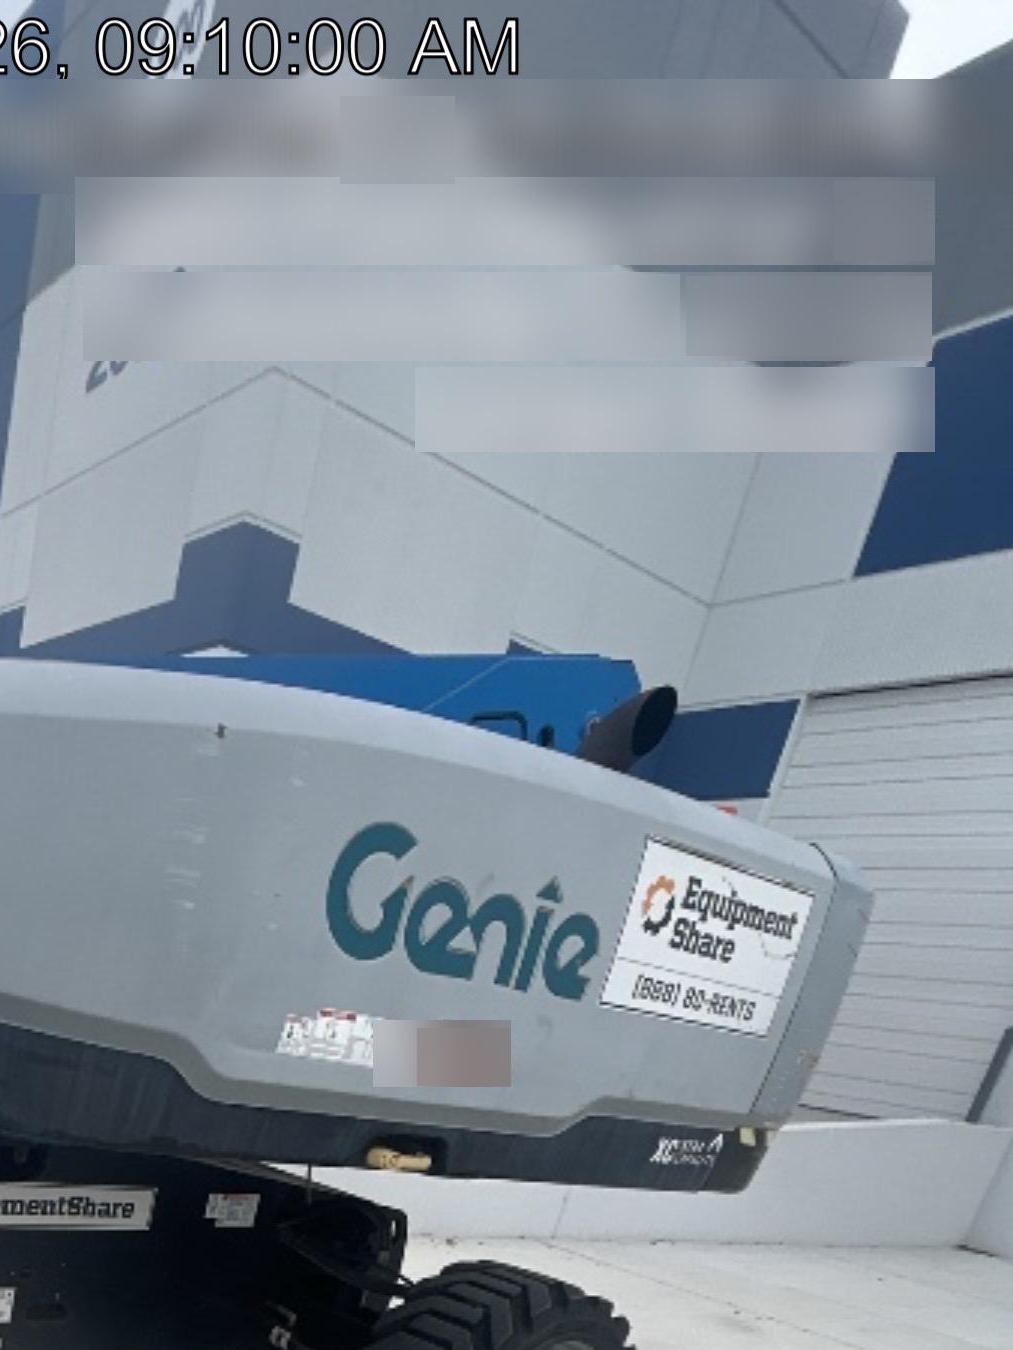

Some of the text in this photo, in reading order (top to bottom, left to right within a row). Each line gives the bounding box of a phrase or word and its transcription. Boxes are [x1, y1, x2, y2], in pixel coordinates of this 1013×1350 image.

[326, 822, 599, 1000] Genie
[668, 916, 736, 963] Share
[681, 875, 799, 940] Equipment
